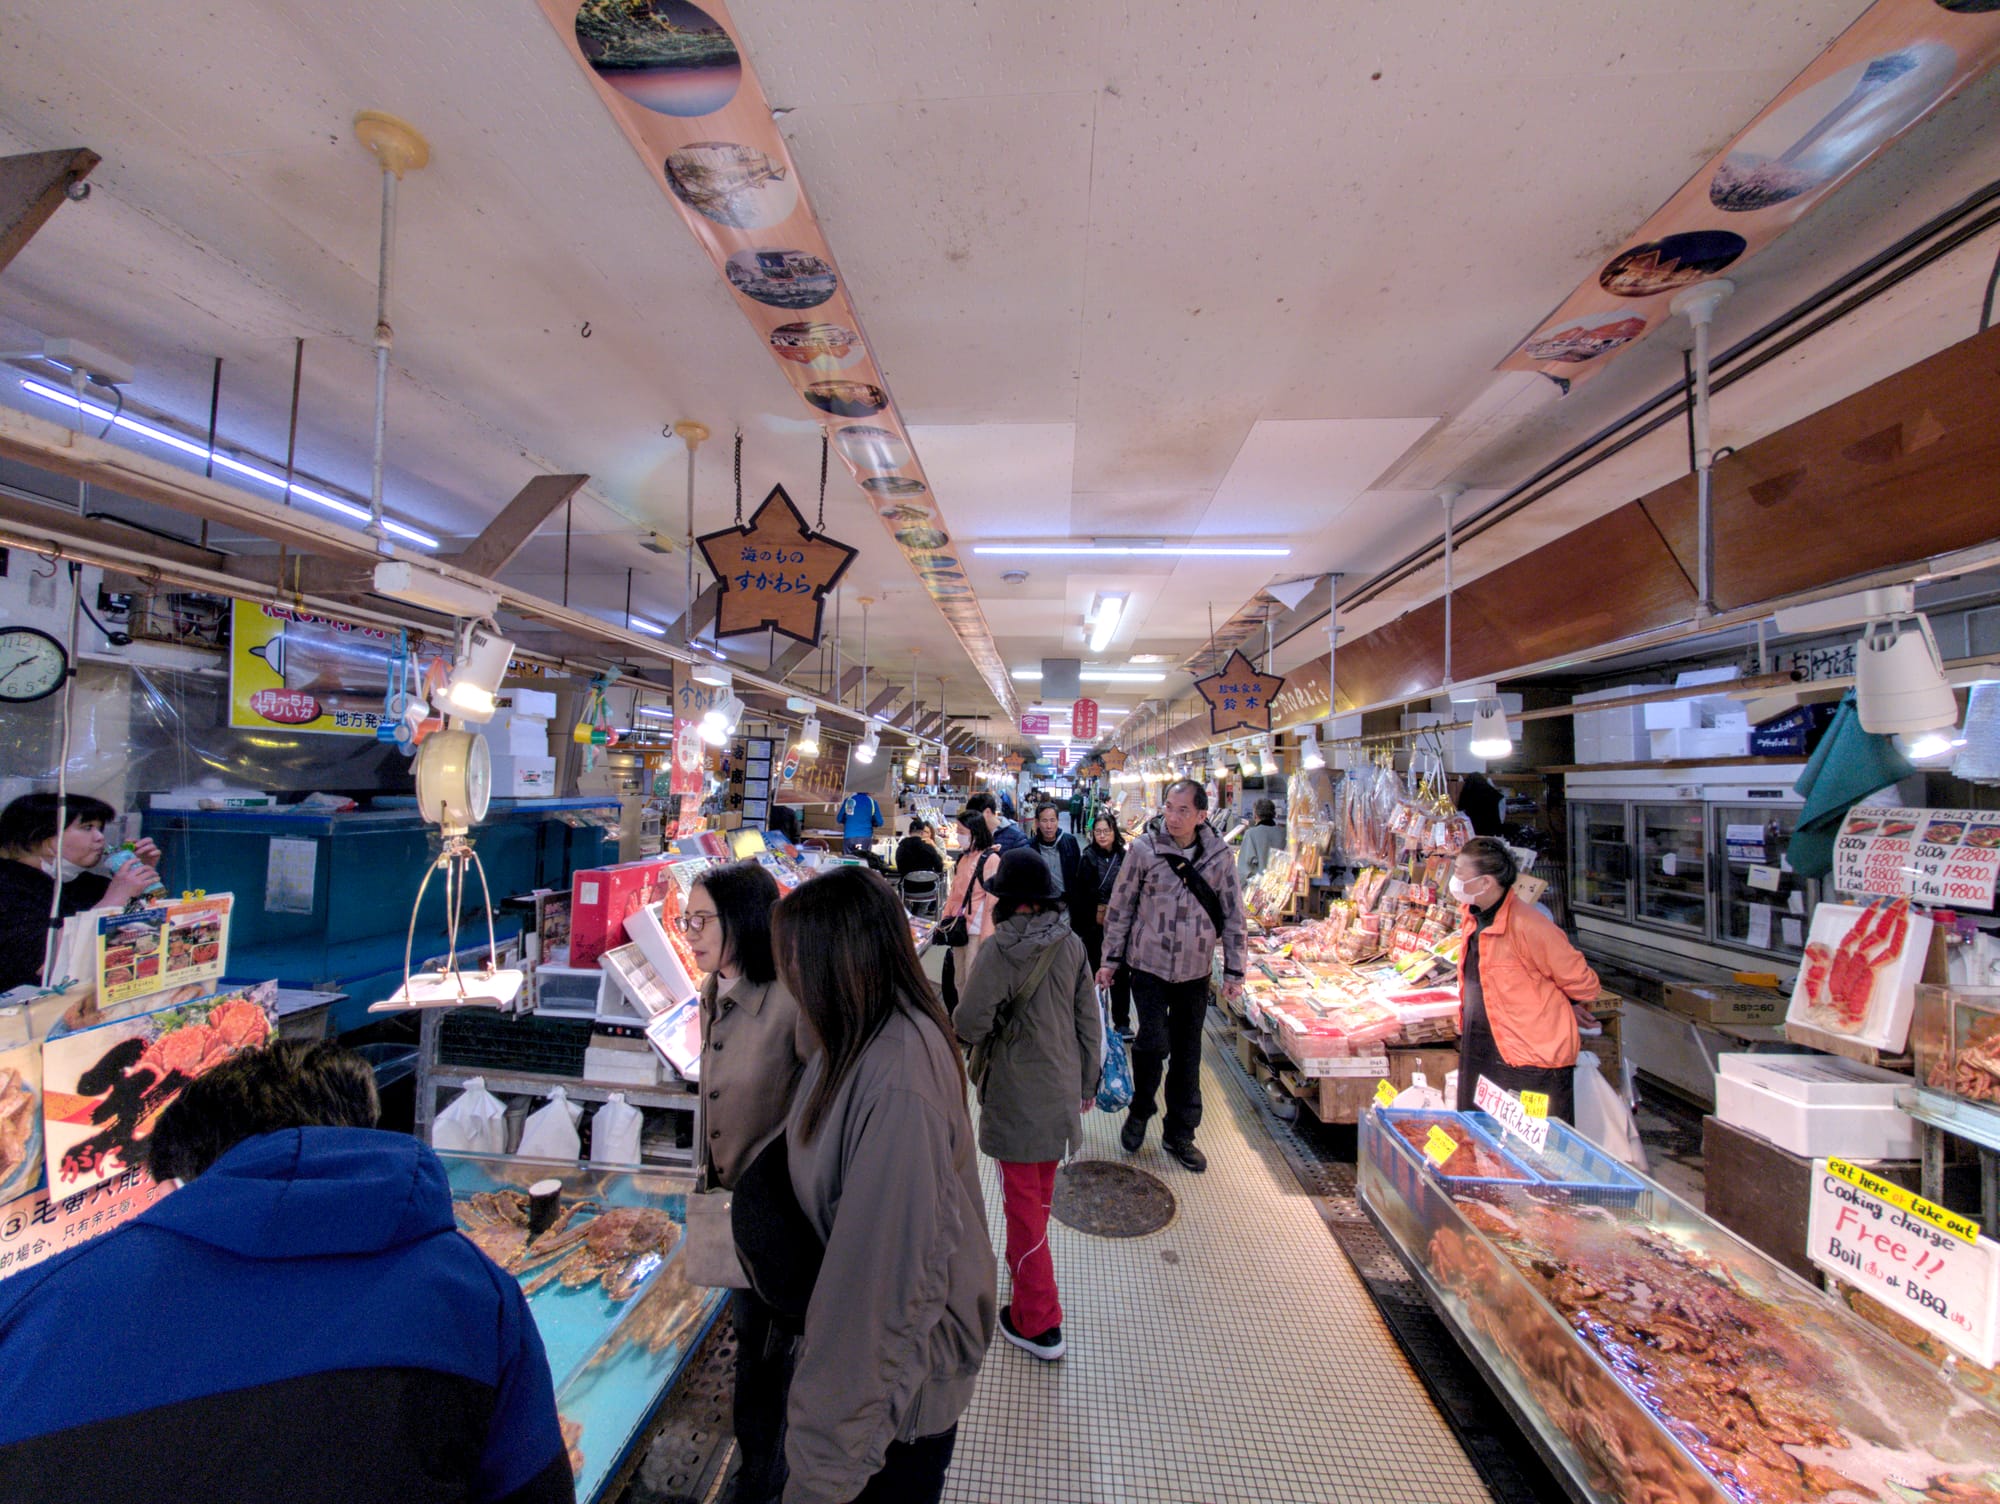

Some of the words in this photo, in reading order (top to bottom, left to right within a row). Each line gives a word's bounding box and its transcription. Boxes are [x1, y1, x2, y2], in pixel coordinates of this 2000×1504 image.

[740, 546, 805, 564] 海のもの
[734, 570, 812, 594] すがわら
[1223, 696, 1260, 711] 鈴木
[1823, 1175, 1883, 1220] Cooking
[1890, 1211, 1956, 1252] charge
[1829, 1160, 1855, 1180] eat
[1859, 1172, 1889, 1196] here
[1910, 1197, 1944, 1223] take
[1946, 1219, 1974, 1240] out
[1828, 1236, 1862, 1271] Boil
[1905, 1279, 1949, 1320] BBQ
